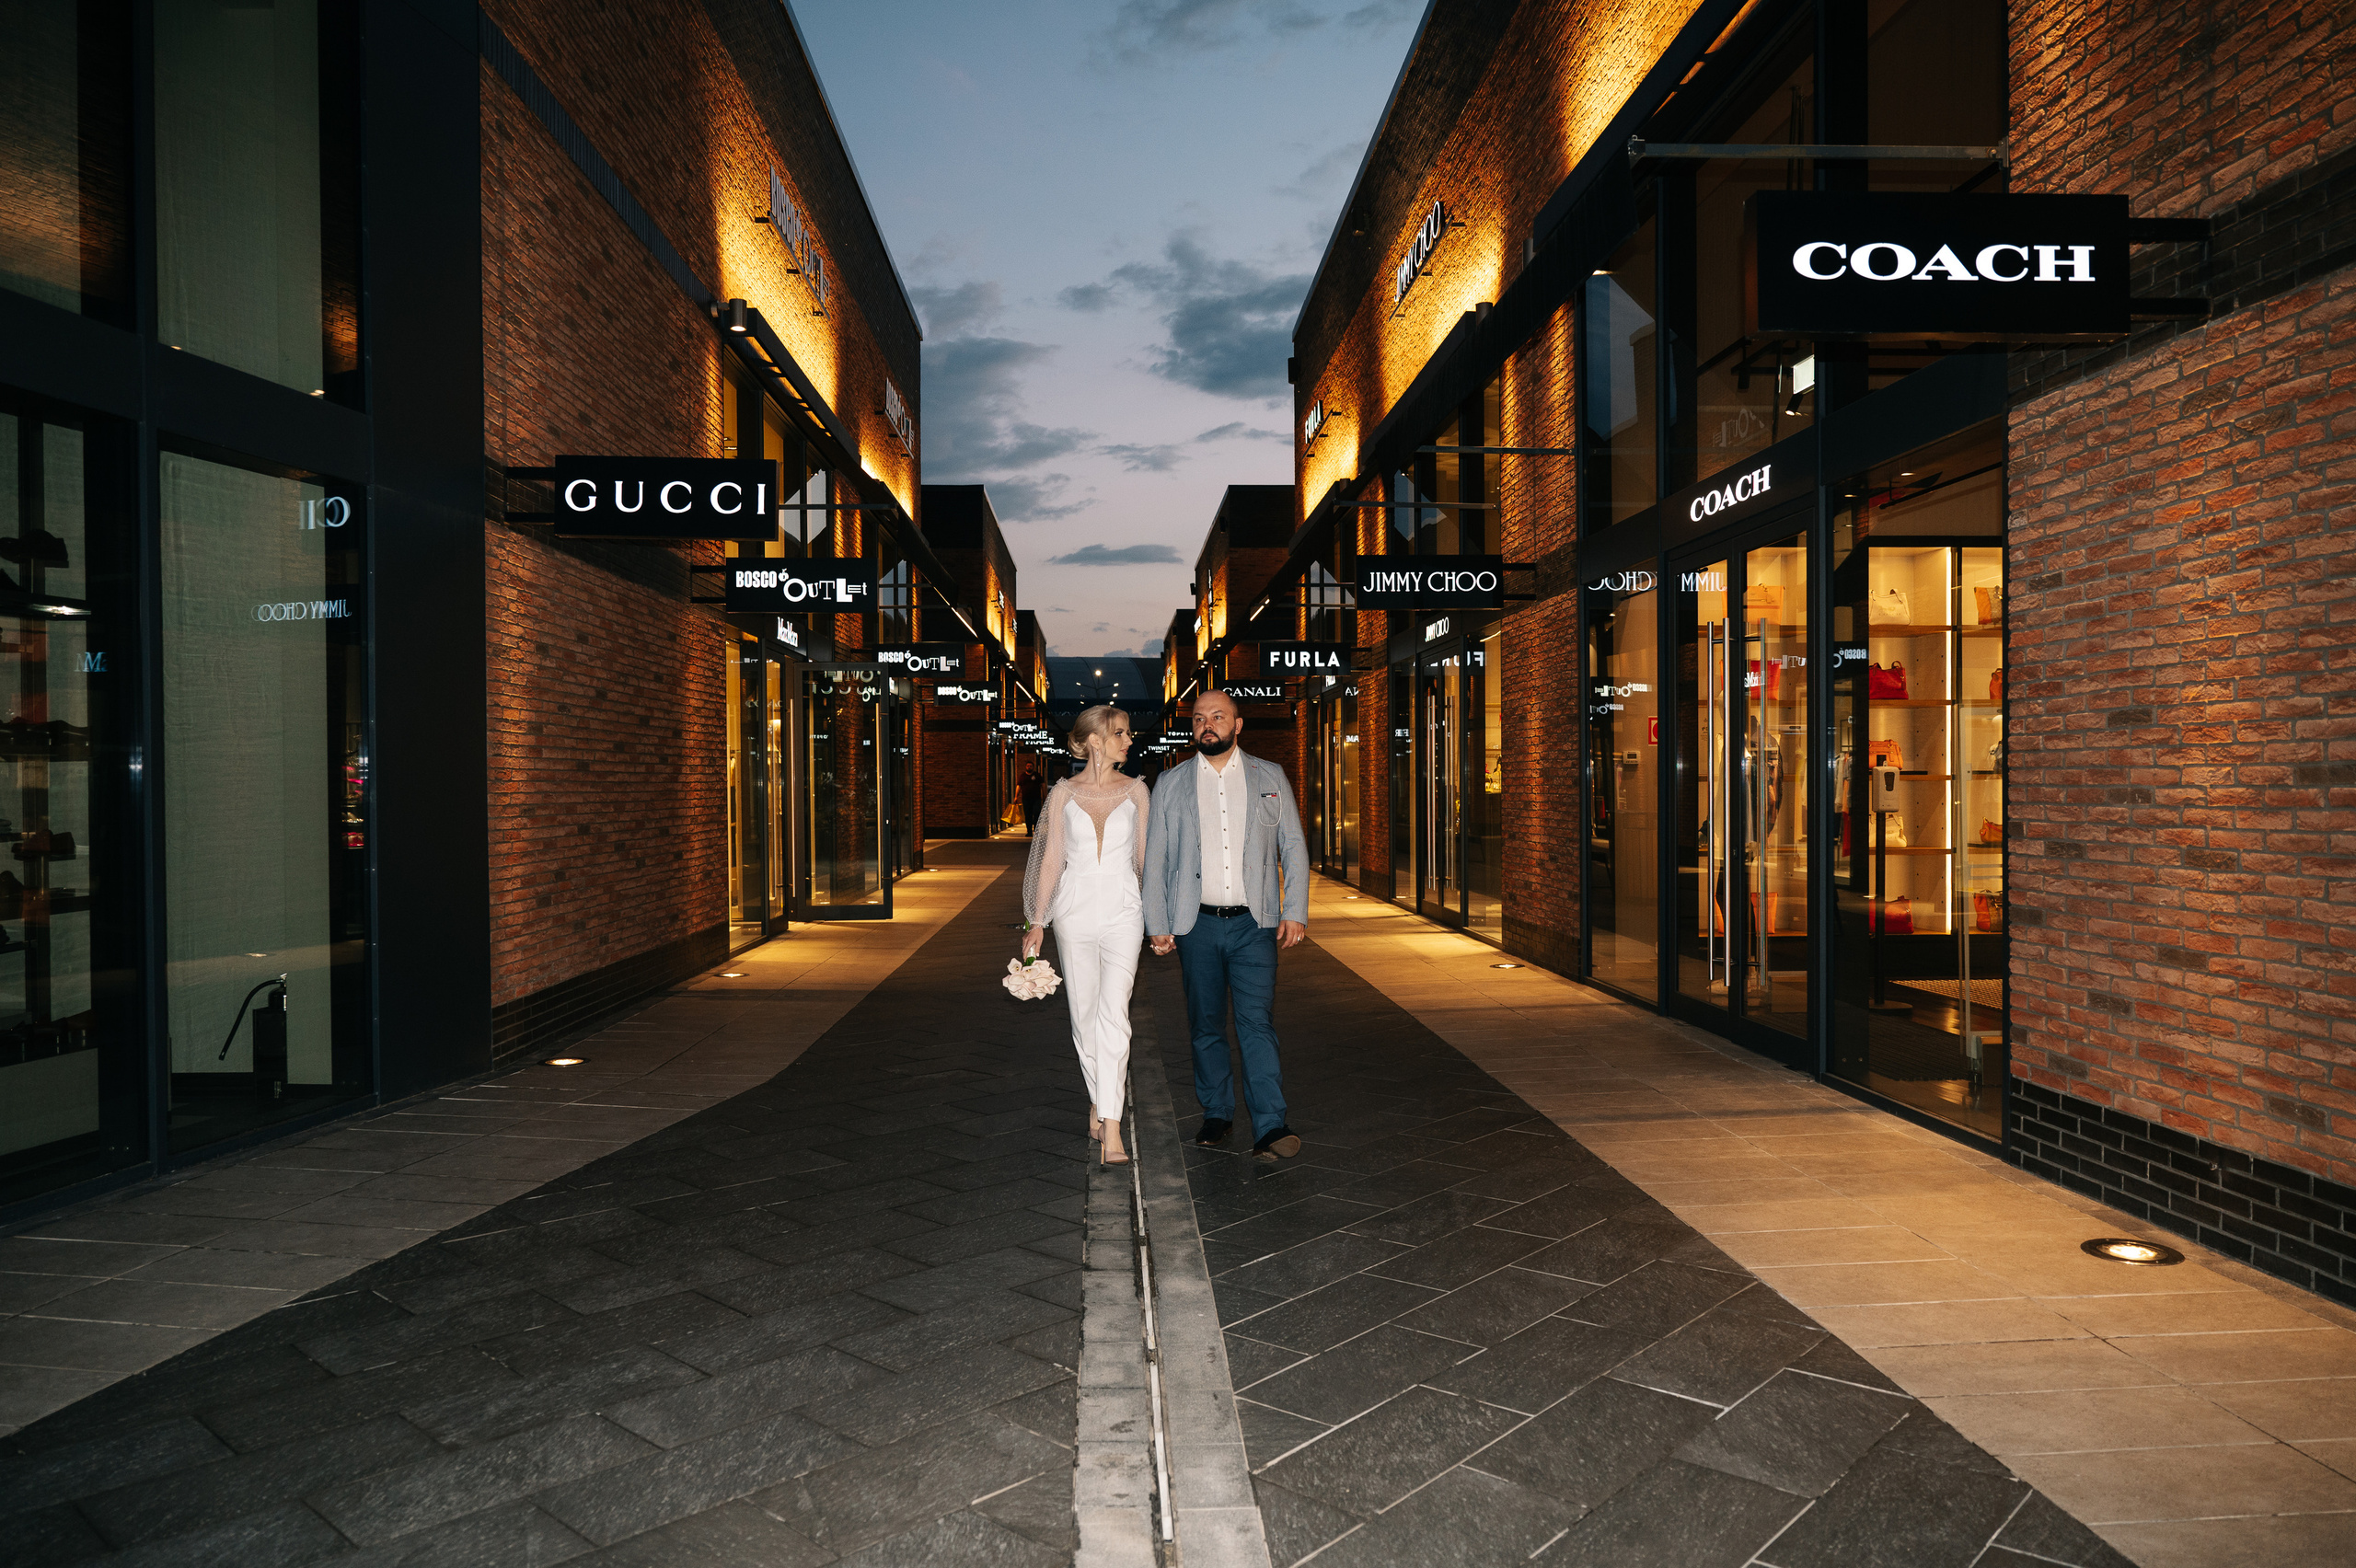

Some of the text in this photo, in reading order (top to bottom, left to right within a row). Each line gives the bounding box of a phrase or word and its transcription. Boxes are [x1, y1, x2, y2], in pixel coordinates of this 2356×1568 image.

[1792, 241, 2096, 282] COACH
[564, 478, 767, 515] GUCCI
[1690, 463, 1772, 523] COACH
[735, 571, 778, 589] BOSCO
[1362, 571, 1497, 593] JIMMY CHOO
[878, 651, 905, 663] BOSCO
[1269, 651, 1341, 668] FURLA
